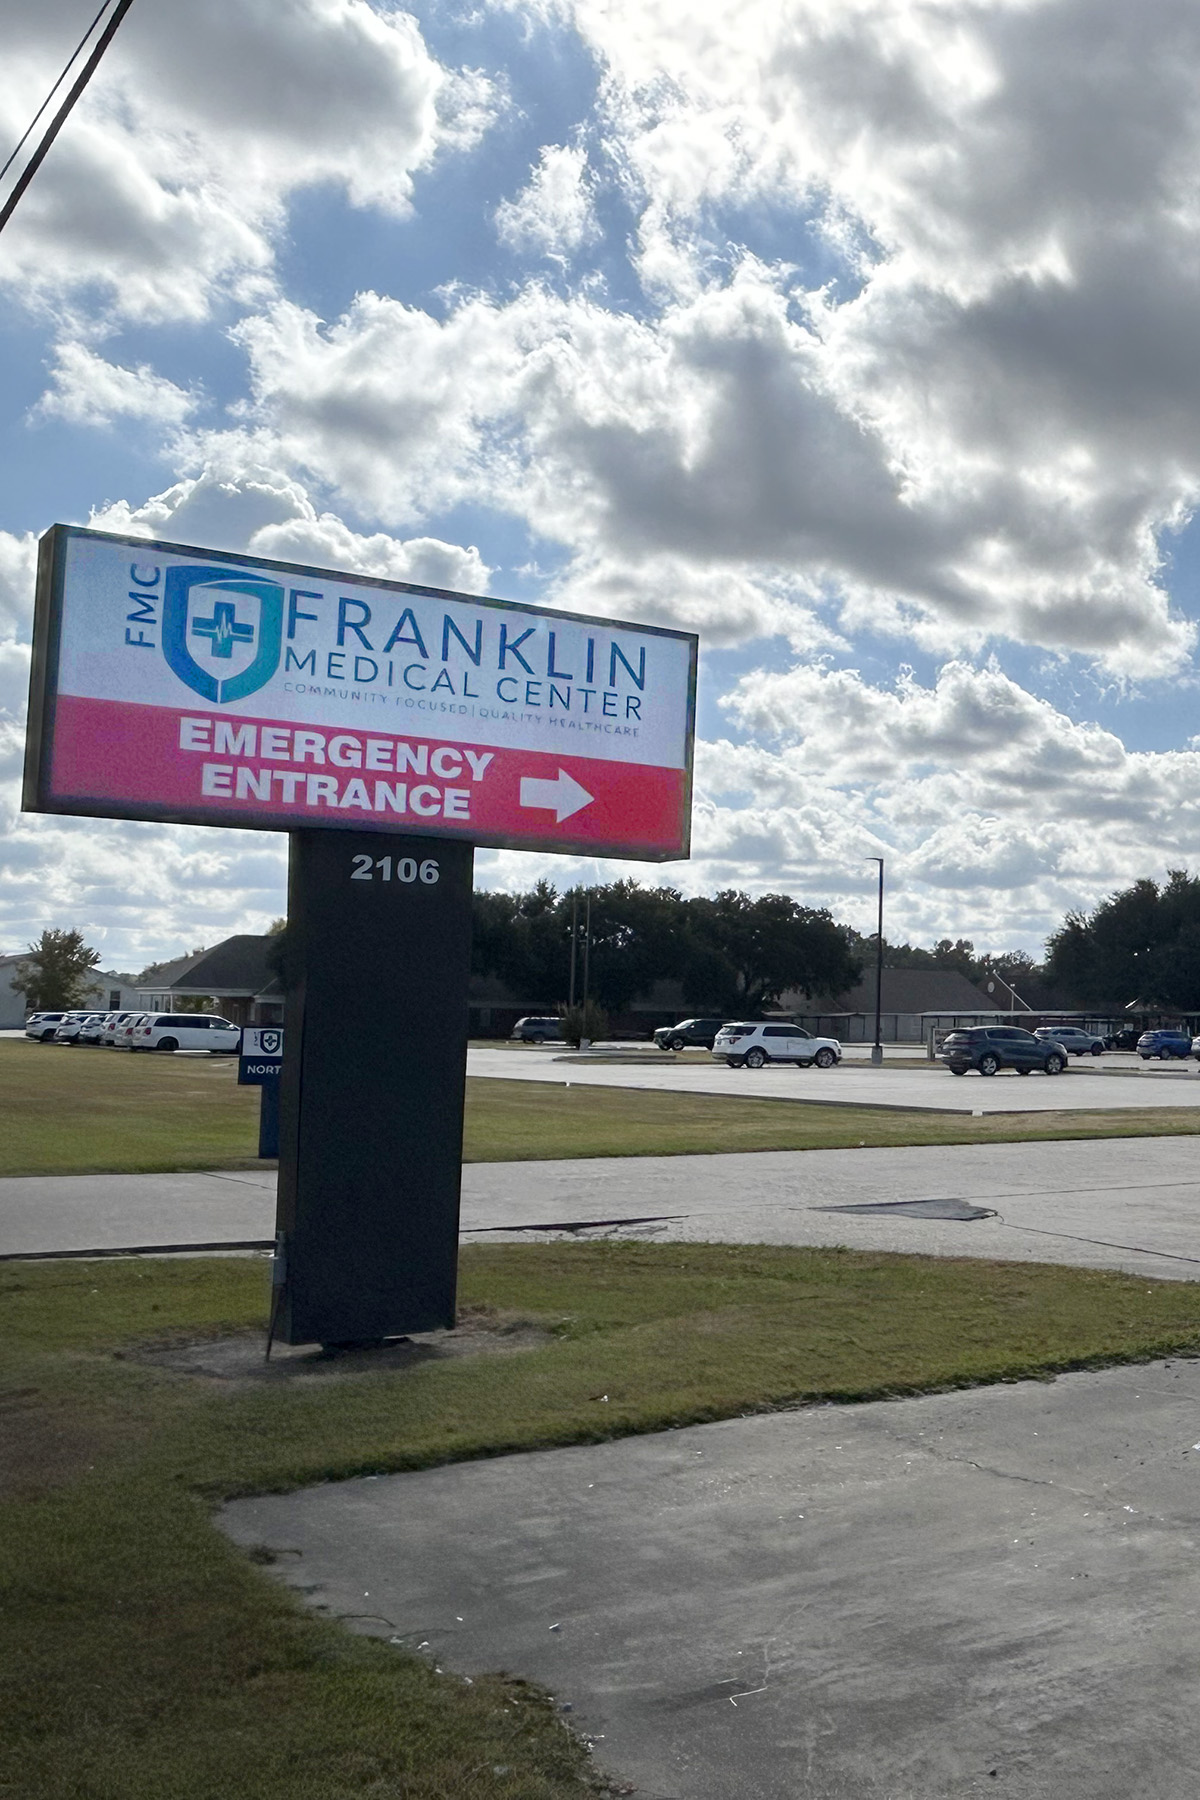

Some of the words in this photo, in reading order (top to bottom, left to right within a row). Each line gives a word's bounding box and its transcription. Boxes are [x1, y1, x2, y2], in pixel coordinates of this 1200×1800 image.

[125, 563, 160, 648] FMC
[287, 588, 646, 691] FRANKLIN
[284, 682, 387, 704] COMMUNITY
[550, 717, 639, 738] HEALTHCARE
[285, 646, 479, 698] MEDICAL
[496, 677, 642, 720] CENTER
[179, 716, 494, 781] EMERGENCY
[202, 763, 470, 819] ENTRANCE
[350, 854, 440, 884] 2106
